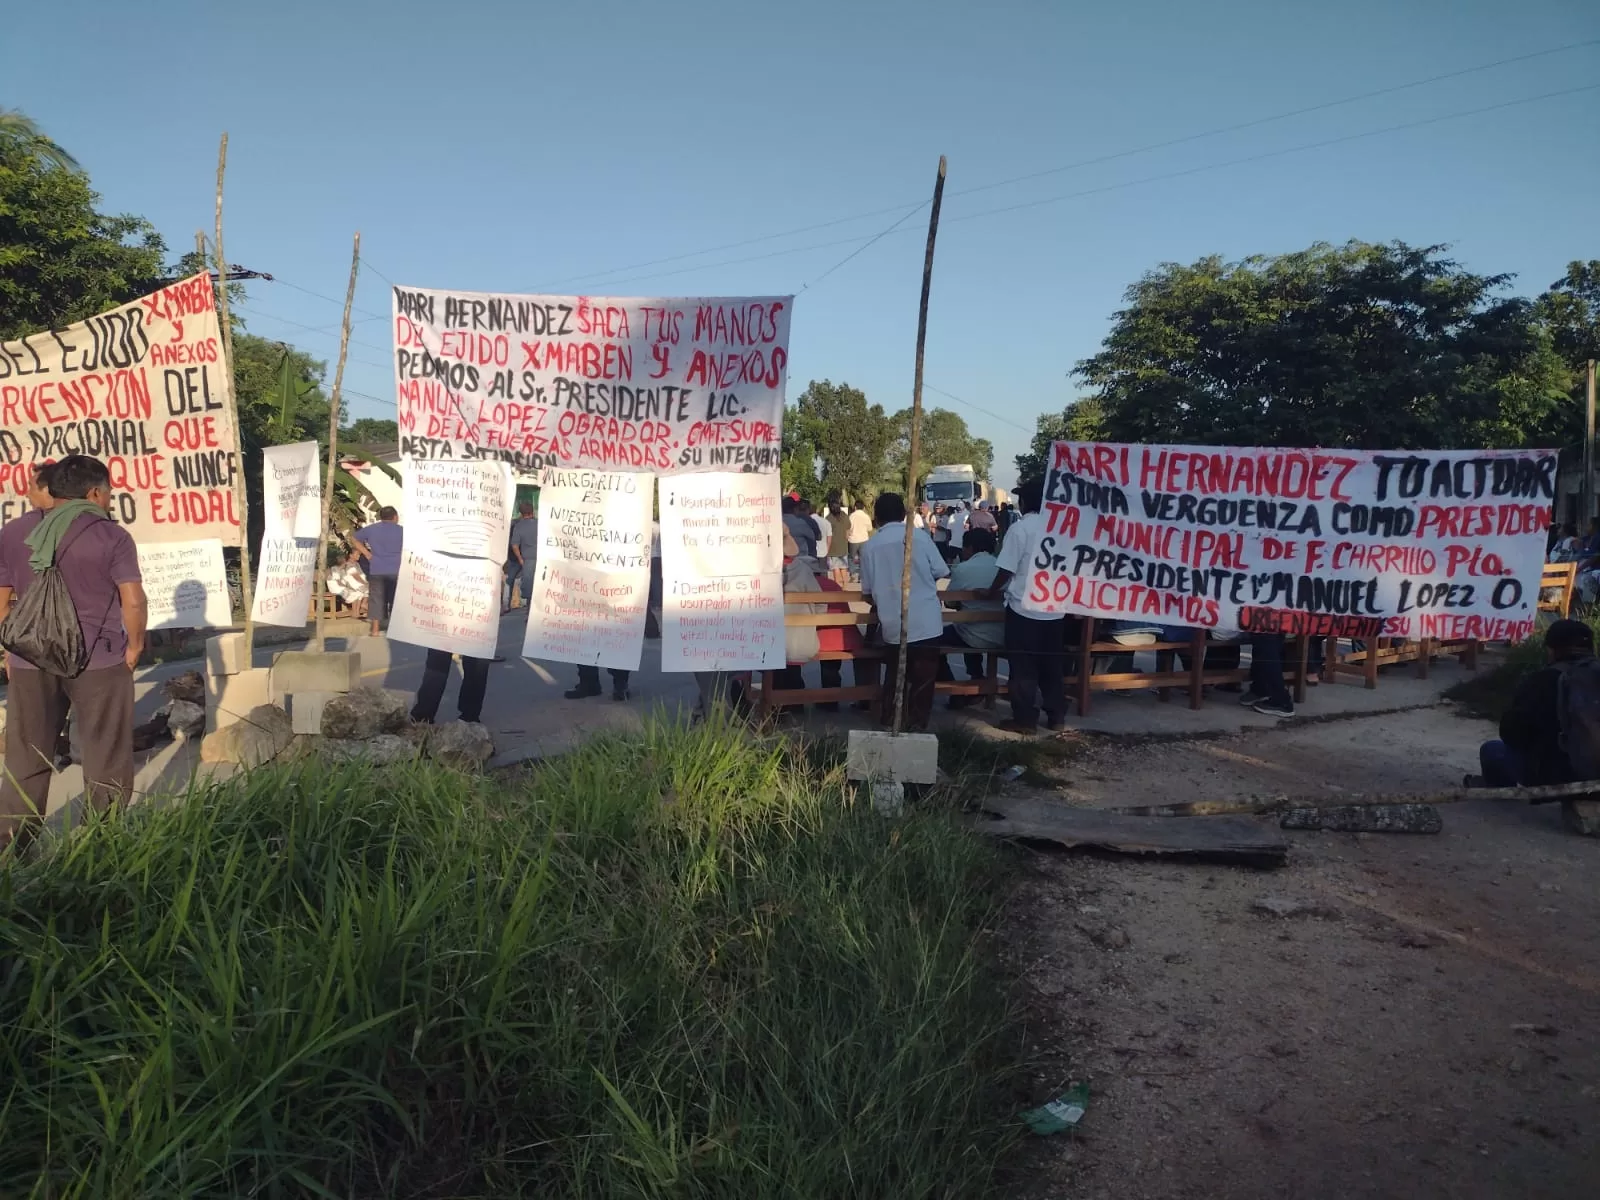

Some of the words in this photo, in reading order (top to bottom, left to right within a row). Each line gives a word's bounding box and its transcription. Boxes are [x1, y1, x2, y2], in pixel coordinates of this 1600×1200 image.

[50, 308, 149, 371] EJIDO
[445, 297, 574, 336] HERNANDEZ
[577, 306, 630, 340] SACA
[639, 306, 684, 345] TUS
[693, 302, 783, 346] MANOS
[150, 337, 217, 367] ANEXOS
[440, 332, 509, 367] EJIDO
[521, 341, 632, 382] XMABEN
[686, 347, 787, 390] ANEXOS
[163, 364, 223, 416] DEL
[551, 376, 693, 422] PRESIDENTE
[28, 419, 157, 460] NACIONAL
[164, 416, 218, 452] QUE
[426, 414, 451, 439] DE
[486, 429, 572, 461] FUERZAS
[678, 447, 702, 466] SU
[477, 400, 548, 433] LOPEZ
[107, 454, 168, 492] QUE
[1140, 449, 1357, 502] HERNANDEZ
[149, 489, 240, 526] EJIDAL
[550, 506, 604, 527] NUESTRO
[1141, 489, 1322, 538] VERGUENZA
[1331, 502, 1414, 538] COMO
[1415, 503, 1553, 539] PRESIDEN
[561, 524, 644, 545] COMISARIADO
[1045, 502, 1081, 539] TA
[1093, 514, 1250, 570] MUNICIPAL
[1262, 537, 1297, 560] DE
[1304, 540, 1326, 574] F.
[1035, 536, 1067, 572] Sr.
[1072, 544, 1247, 604] PRESIDENTE
[1259, 571, 1384, 615] MANUEL
[1397, 579, 1475, 614] LOPEZ
[1491, 578, 1528, 610] O.
[1030, 571, 1220, 627] SOLICITAMOS
[1384, 616, 1411, 635] SU
